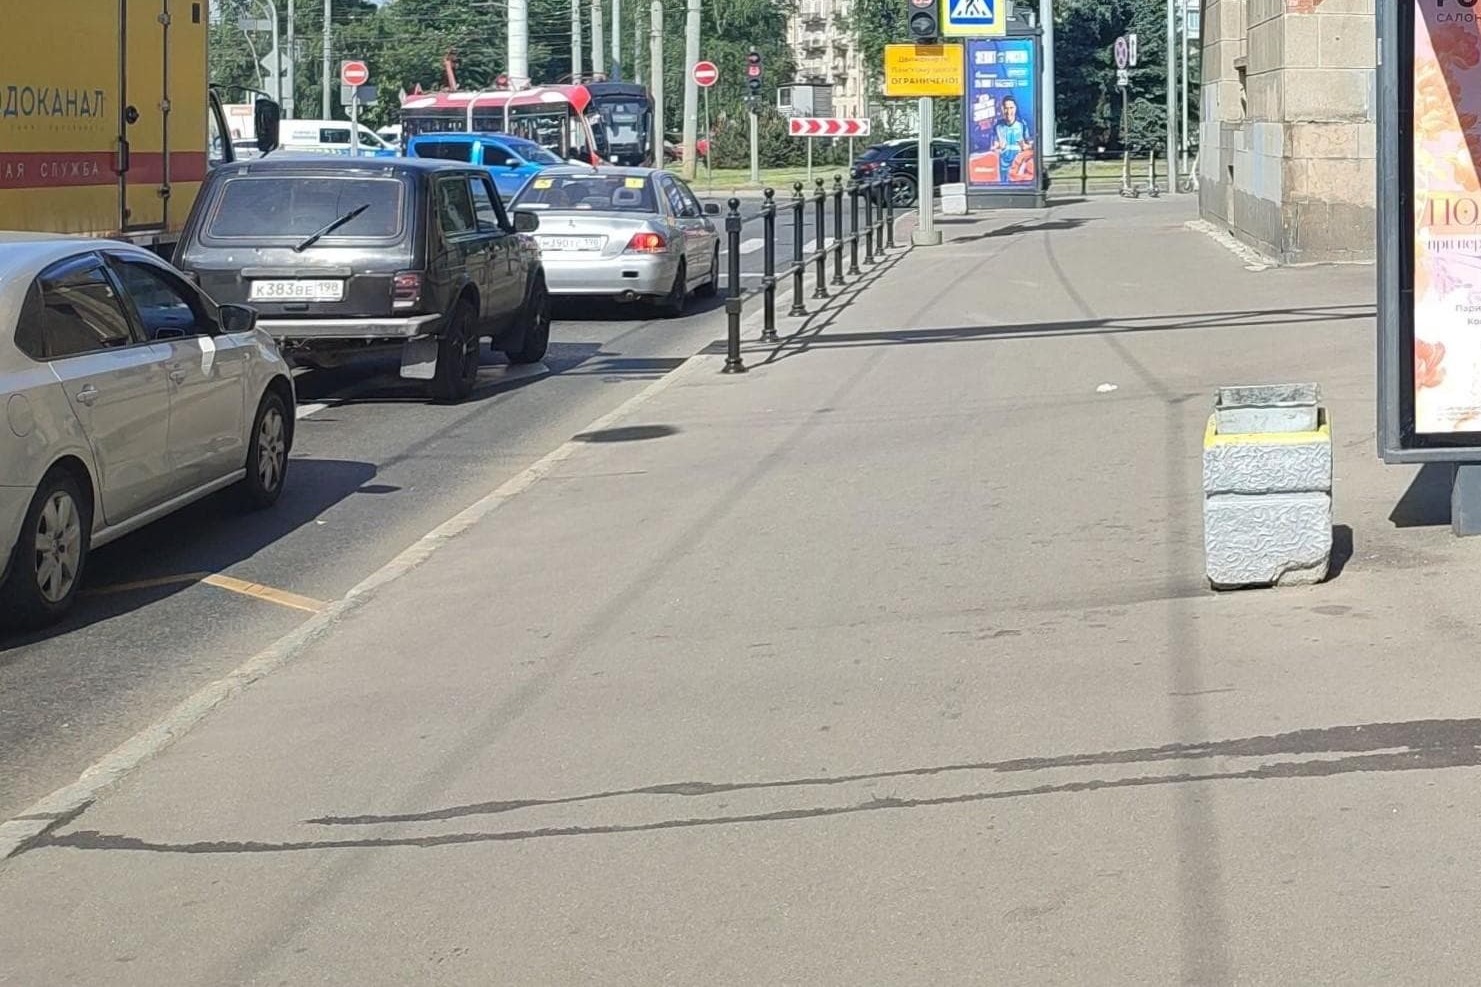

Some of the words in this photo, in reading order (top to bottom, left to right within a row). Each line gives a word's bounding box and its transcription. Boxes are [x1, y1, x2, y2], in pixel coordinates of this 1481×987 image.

[0, 86, 104, 117] ДОКАНАЛ
[0, 162, 25, 181] АЯ
[40, 160, 99, 178] СЛУЖБА
[1428, 239, 1454, 252] при
